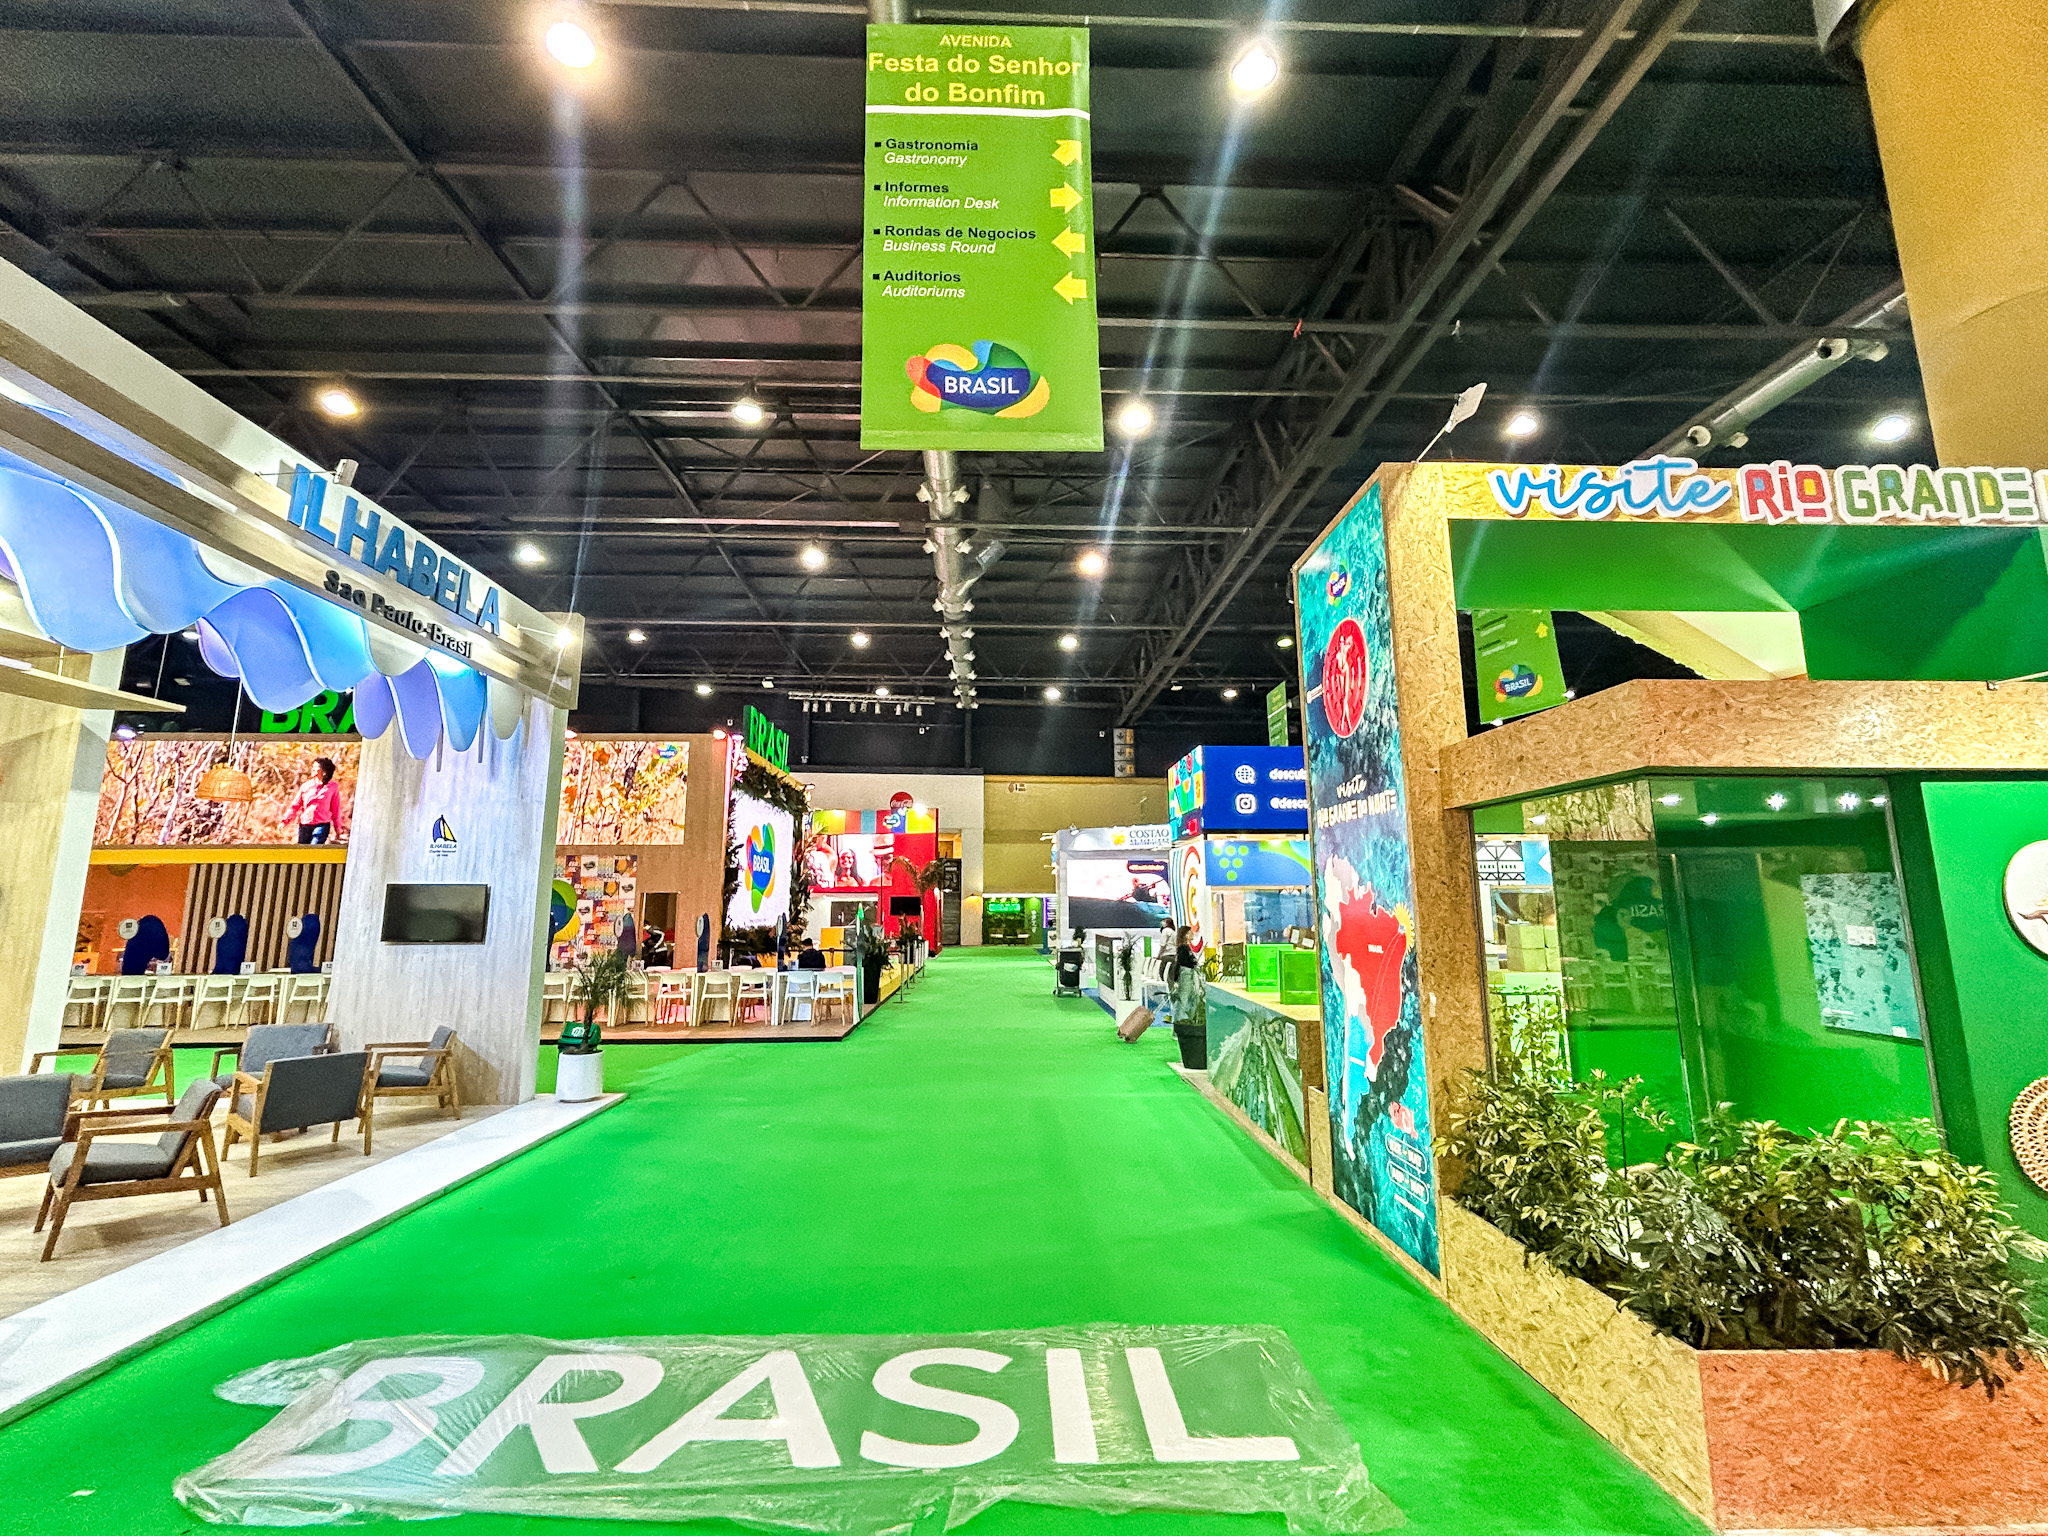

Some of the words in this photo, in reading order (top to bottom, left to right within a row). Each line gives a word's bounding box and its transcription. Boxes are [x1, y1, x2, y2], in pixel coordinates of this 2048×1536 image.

[939, 34, 1012, 48] AVENIDA
[868, 53, 939, 73] Festa
[947, 54, 980, 74] do
[988, 55, 1081, 76] Senhor
[905, 82, 939, 102] do
[948, 83, 1045, 105] Bonfim
[884, 152, 967, 168] Gastronomy
[885, 182, 949, 194] Informes
[883, 195, 960, 208] Information
[964, 197, 1000, 209] Desk
[885, 226, 940, 238] Rondas
[945, 226, 963, 238] de
[968, 227, 1036, 241] Negocios
[883, 240, 946, 253] Business
[950, 241, 996, 254] Round
[883, 270, 961, 283] Auditorios
[881, 285, 966, 299] Auditoriums
[944, 376, 1020, 395] BRASIL
[1496, 459, 1731, 514] visite
[1842, 468, 2034, 518] GRANDE
[287, 463, 500, 636] ILHABELA
[1505, 678, 1532, 693] BRASIL
[747, 705, 790, 774] BRASIL
[752, 854, 771, 874] BRASIL
[252, 1346, 1301, 1474] BRASIL
